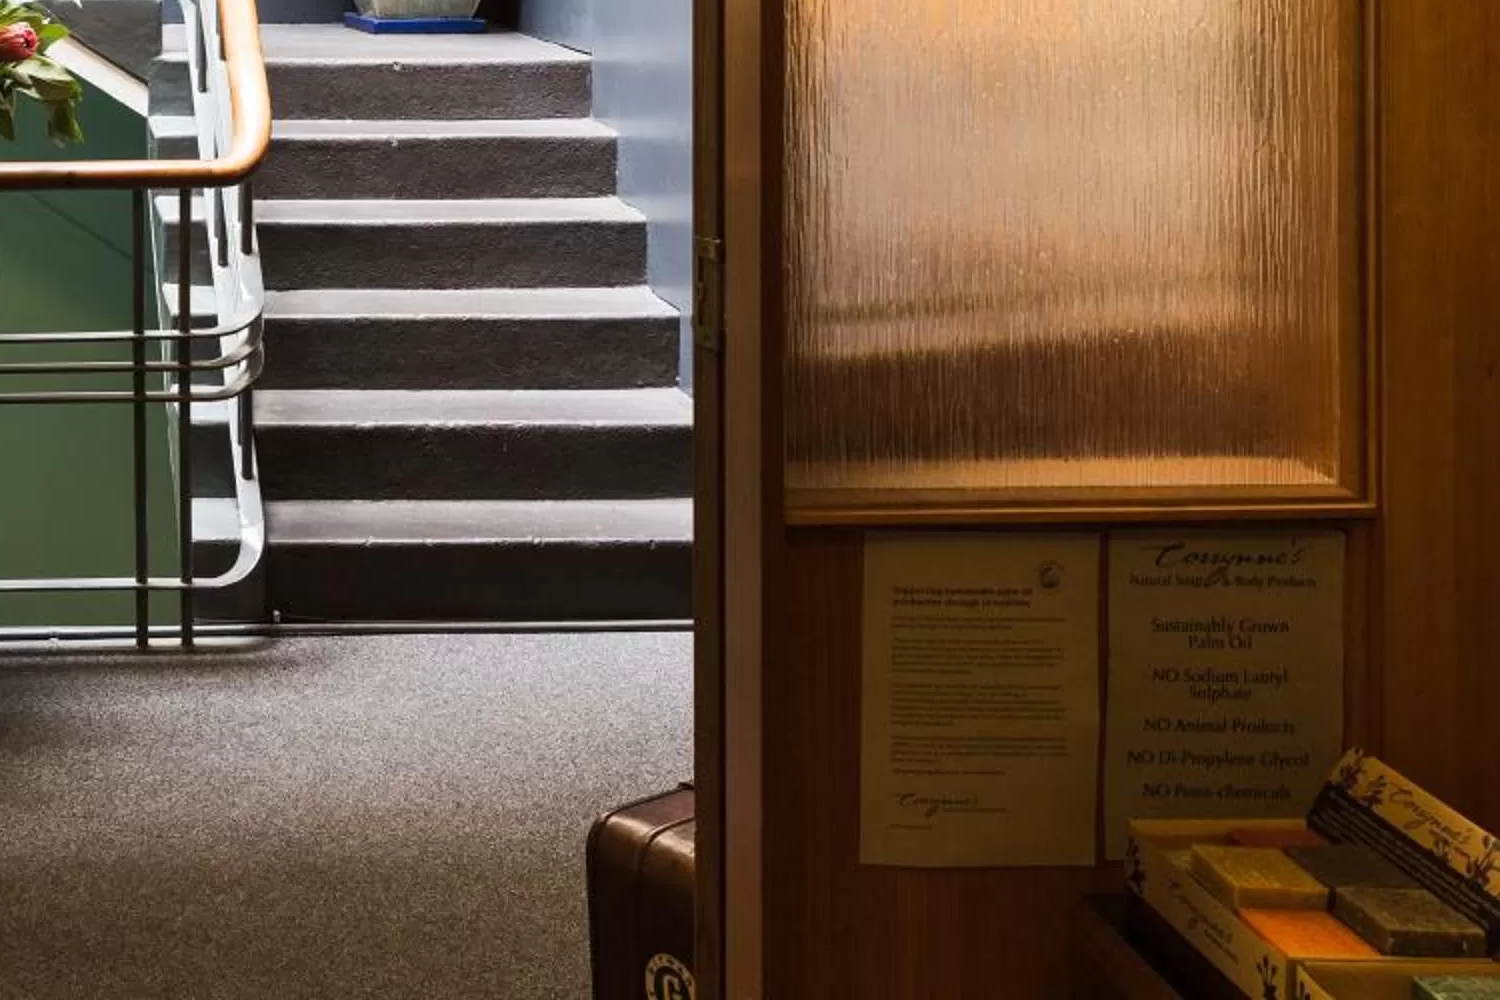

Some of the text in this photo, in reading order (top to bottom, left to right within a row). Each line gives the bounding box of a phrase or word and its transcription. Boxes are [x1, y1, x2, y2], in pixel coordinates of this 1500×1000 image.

[1239, 616, 1292, 633] Grown
[1188, 634, 1253, 649] Palm Oil
[1152, 667, 1180, 683] NO
[1183, 667, 1239, 684] Sodium
[1143, 715, 1296, 735] NO Animal Products
[1126, 750, 1155, 765] NO
[1142, 782, 1171, 798] NO
